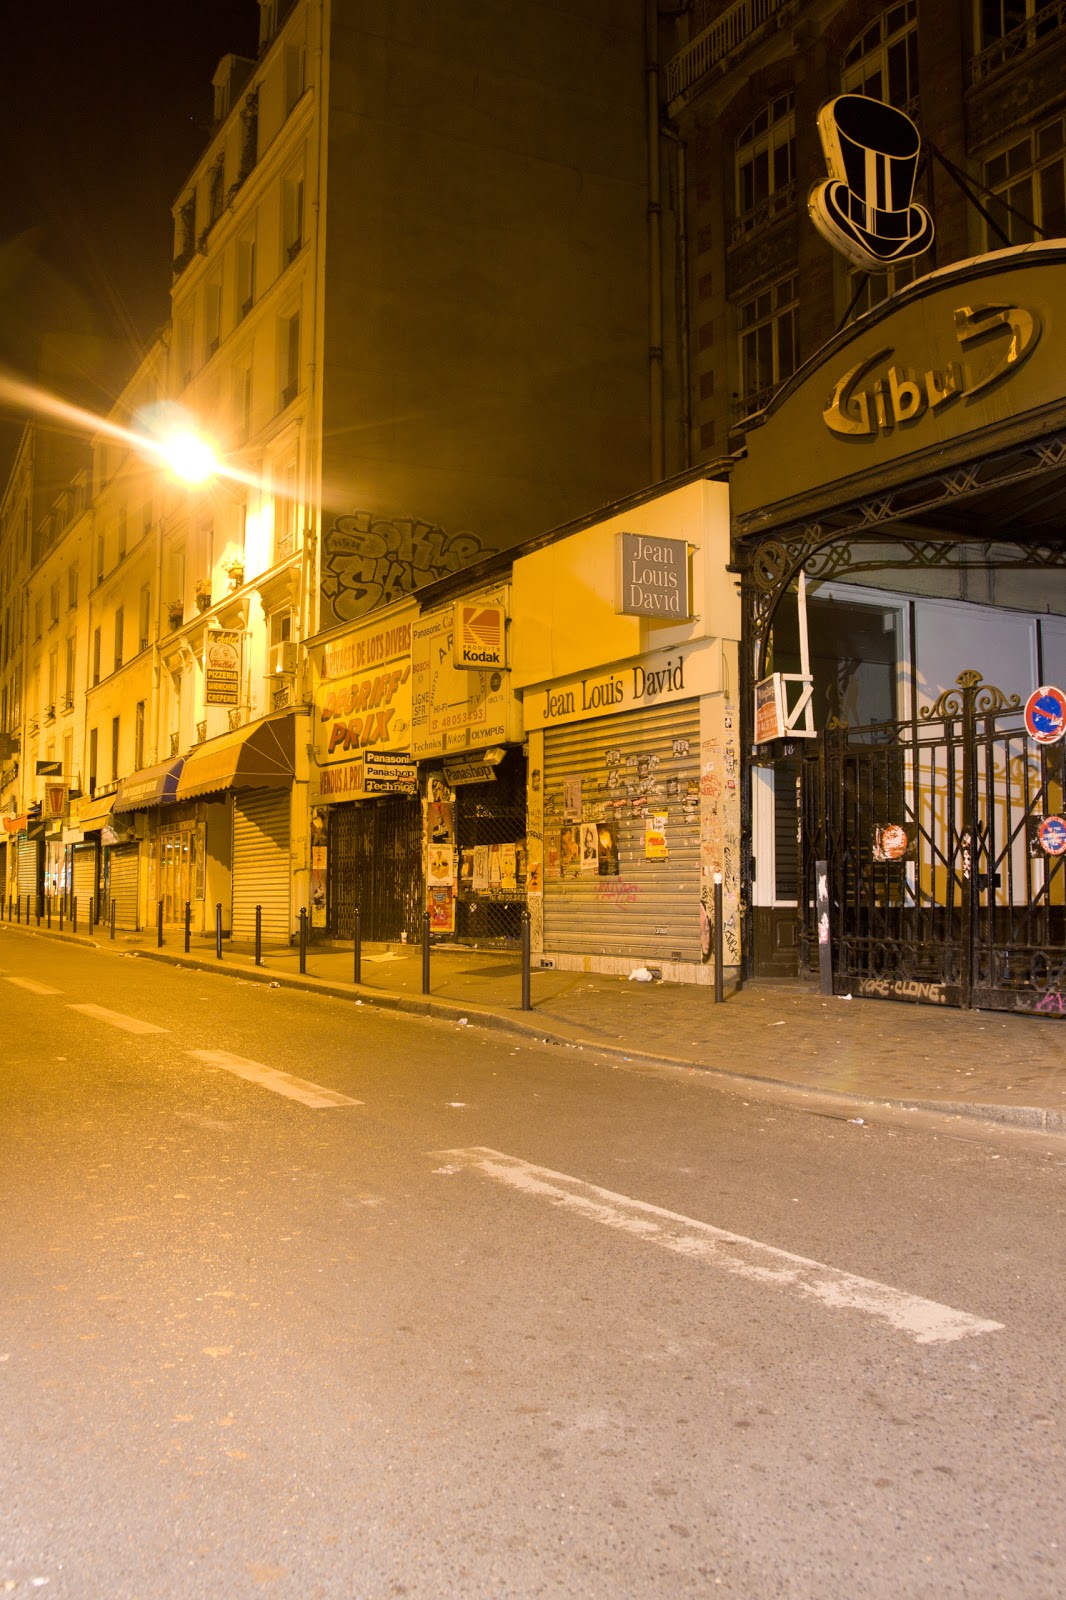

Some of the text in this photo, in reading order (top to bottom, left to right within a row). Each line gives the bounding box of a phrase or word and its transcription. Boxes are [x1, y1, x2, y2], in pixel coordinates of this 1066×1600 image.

[634, 537, 674, 564] Jean
[631, 560, 678, 589] Louis
[630, 584, 681, 612] David
[216, 631, 239, 645] chalet
[413, 616, 454, 641] Panasonic Ca
[356, 641, 365, 668] DE
[367, 633, 384, 664] LOTS
[385, 623, 411, 658] DIVERS
[463, 650, 501, 663] Kodak
[208, 670, 238, 680] PIZZERIA
[412, 660, 430, 674] BOSCH
[208, 694, 237, 703] CREPERIE
[543, 656, 685, 719] Jean Louis David
[414, 704, 426, 717] SFR
[327, 708, 396, 754] PRIX
[413, 725, 505, 752] Technics Nikon OLYMPUS
[319, 768, 342, 795] VENDUS
[367, 767, 415, 777] Panashop
[445, 764, 492, 782] Panashop
